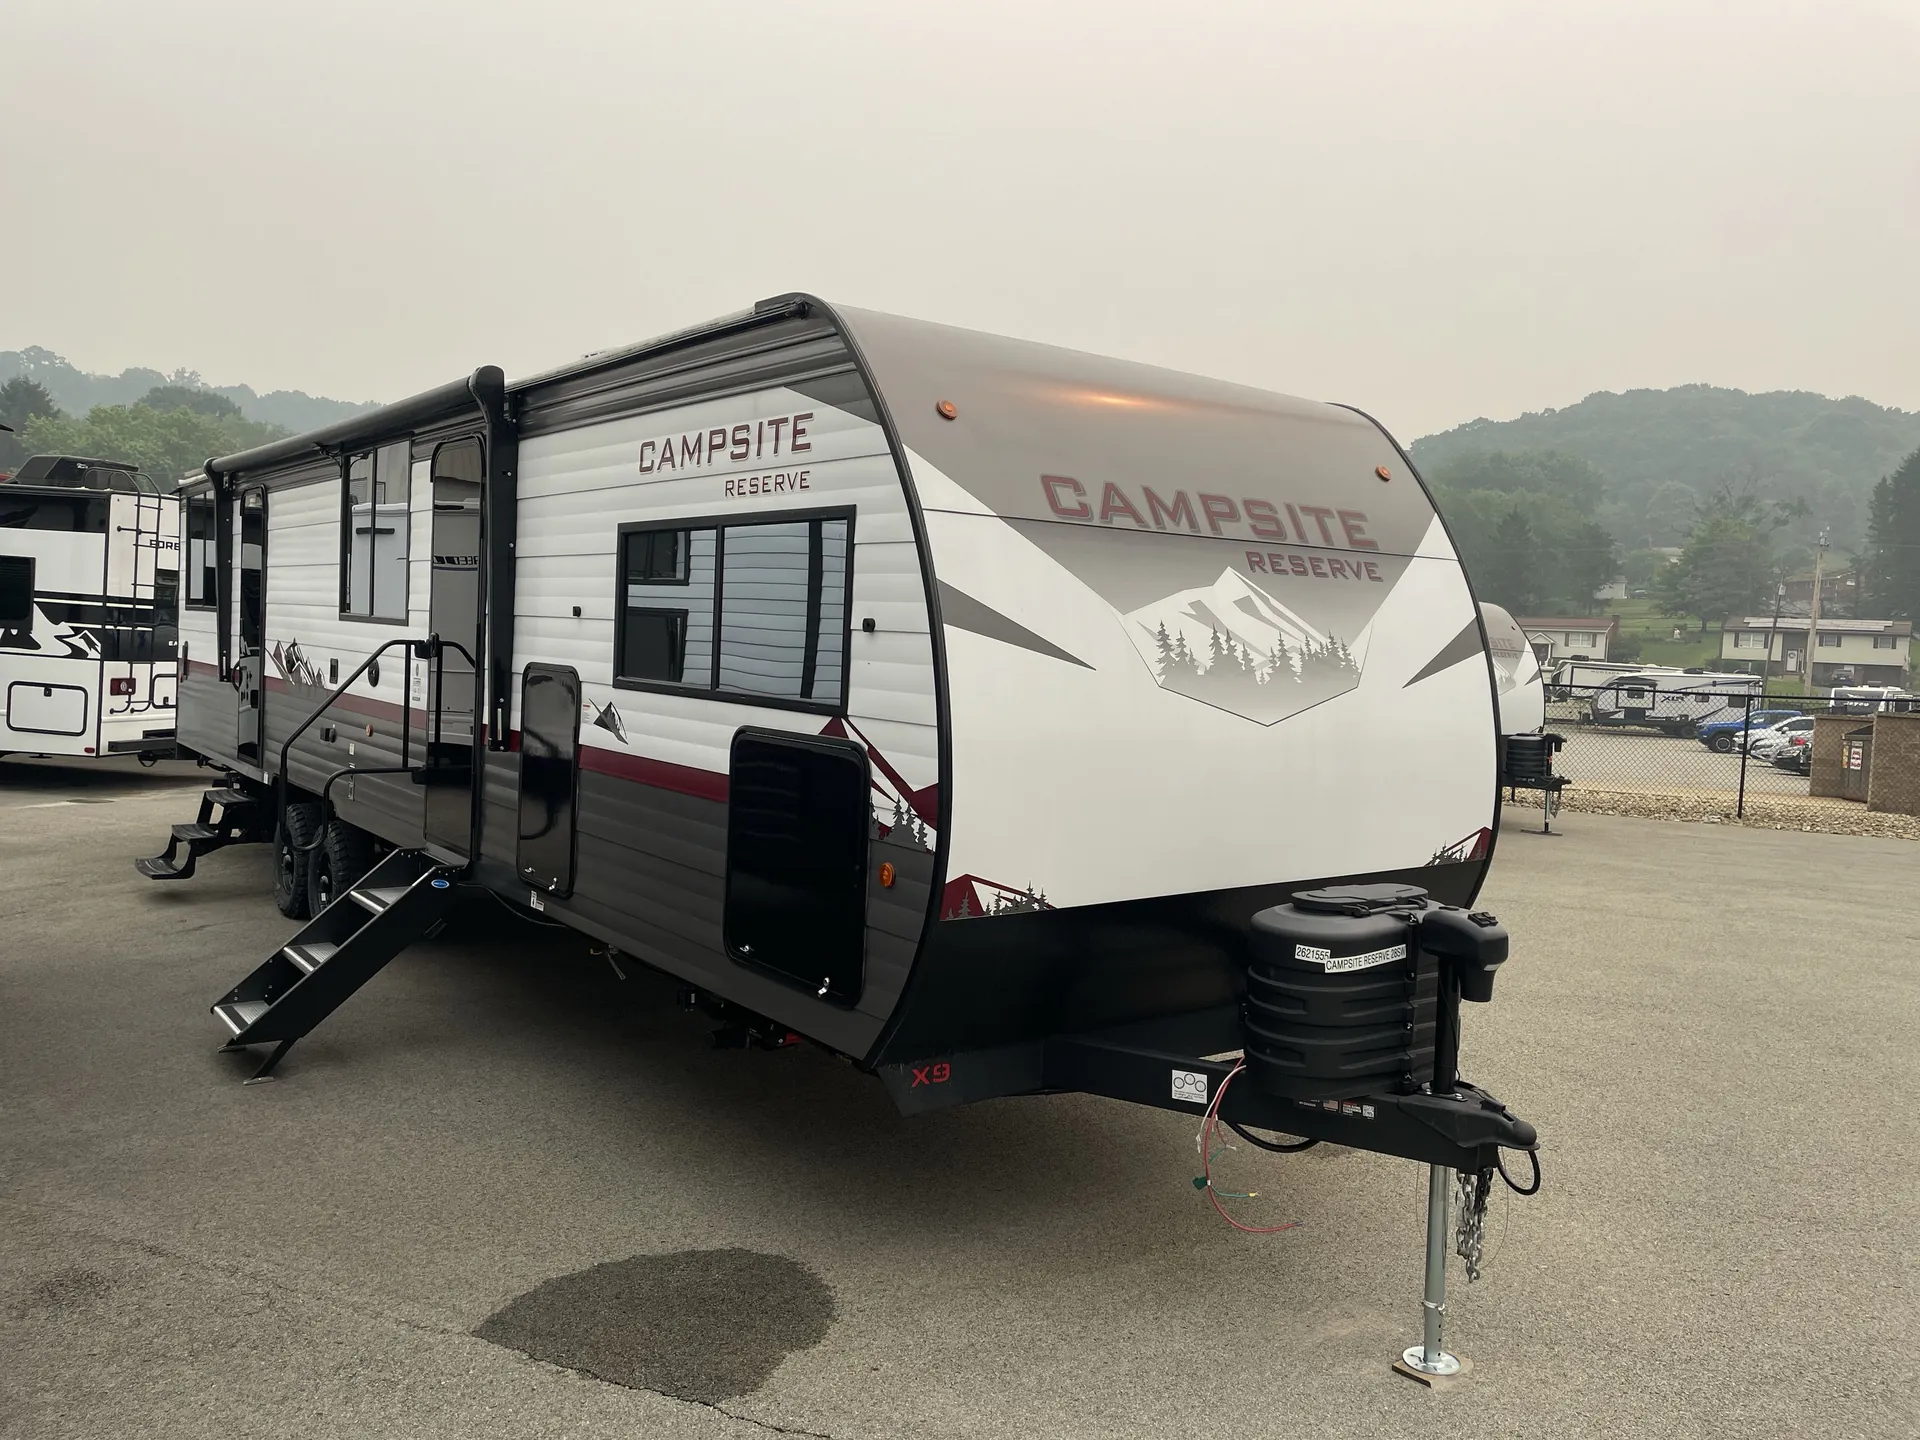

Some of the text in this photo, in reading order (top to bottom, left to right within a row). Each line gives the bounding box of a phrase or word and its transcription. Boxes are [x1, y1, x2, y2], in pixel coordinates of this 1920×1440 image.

[639, 412, 814, 473] CAMPSITE
[725, 470, 811, 497] RESERVE
[1040, 474, 1379, 550] CAMPSITE
[1245, 551, 1384, 582] RESERVE
[1296, 946, 1330, 961] 2621555
[1325, 957, 1363, 970] CAMPSITE
[1364, 950, 1390, 965] RESERVE
[911, 1063, 951, 1088] X9
